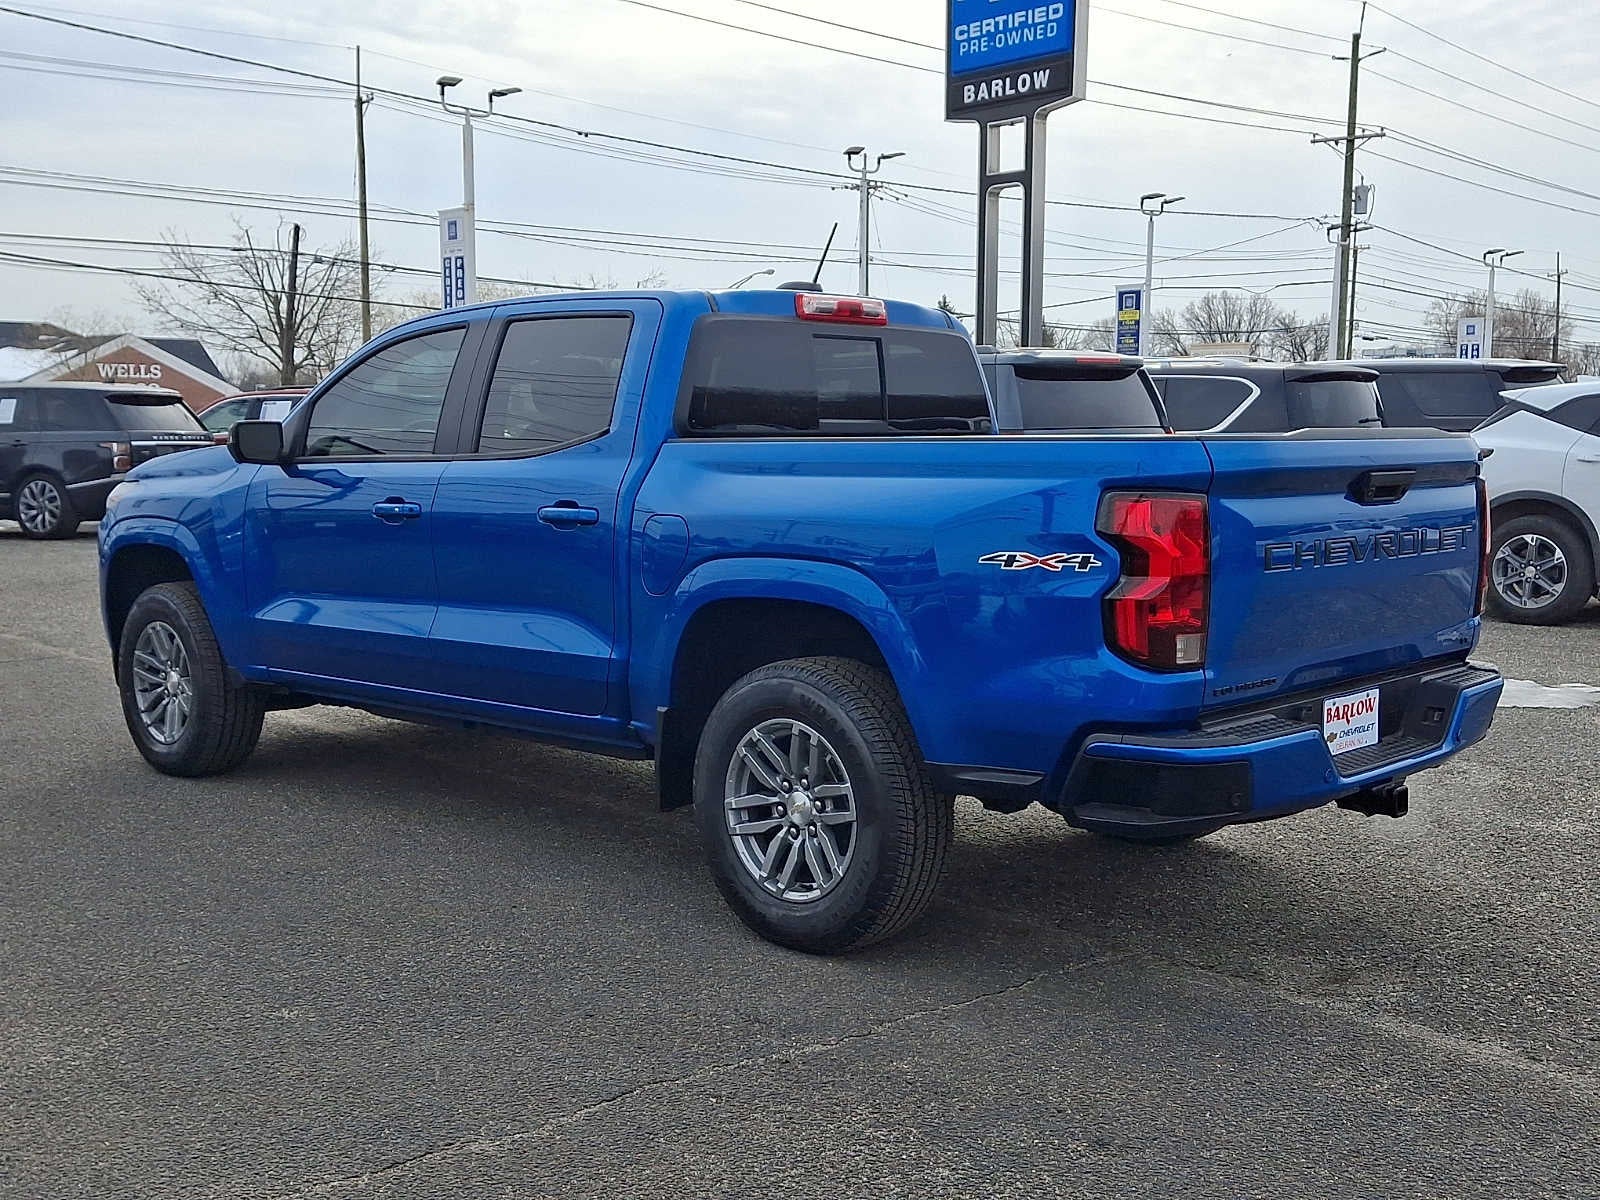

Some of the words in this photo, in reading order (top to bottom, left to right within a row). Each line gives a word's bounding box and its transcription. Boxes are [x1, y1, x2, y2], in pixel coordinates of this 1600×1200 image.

[955, 3, 1064, 41] CERTIFIED
[959, 22, 1057, 56] PRE-OWNED
[963, 69, 1051, 104] BARLOW
[96, 363, 162, 379] WELLS
[1264, 524, 1473, 573] CHEVROLET
[1326, 697, 1377, 726] BARLOW
[1338, 722, 1376, 739] CHEVROLET
